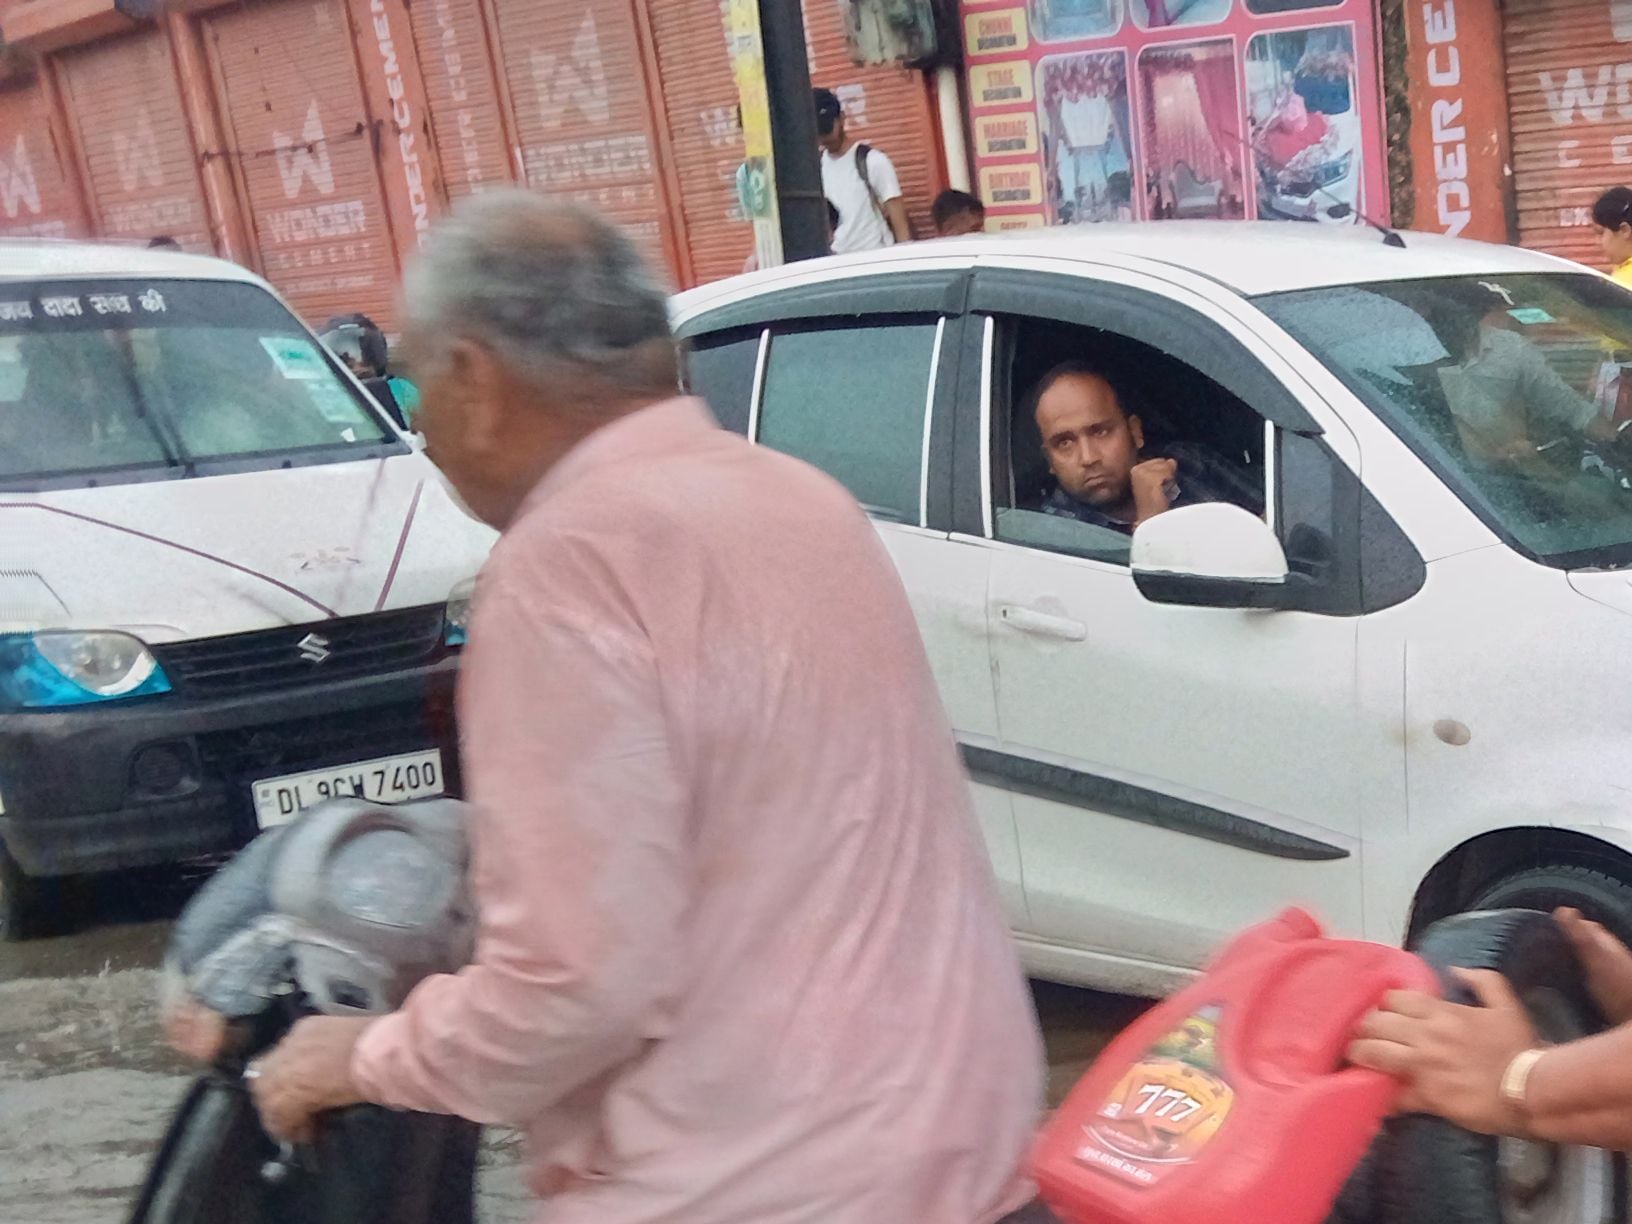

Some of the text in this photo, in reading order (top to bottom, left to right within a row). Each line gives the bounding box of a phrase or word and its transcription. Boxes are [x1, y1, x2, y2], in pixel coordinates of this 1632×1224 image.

[1423, 0, 1472, 238] NDER CE
[265, 199, 368, 243] WONDER
[372, 761, 436, 797] 7400
[1134, 1083, 1203, 1122] 777
